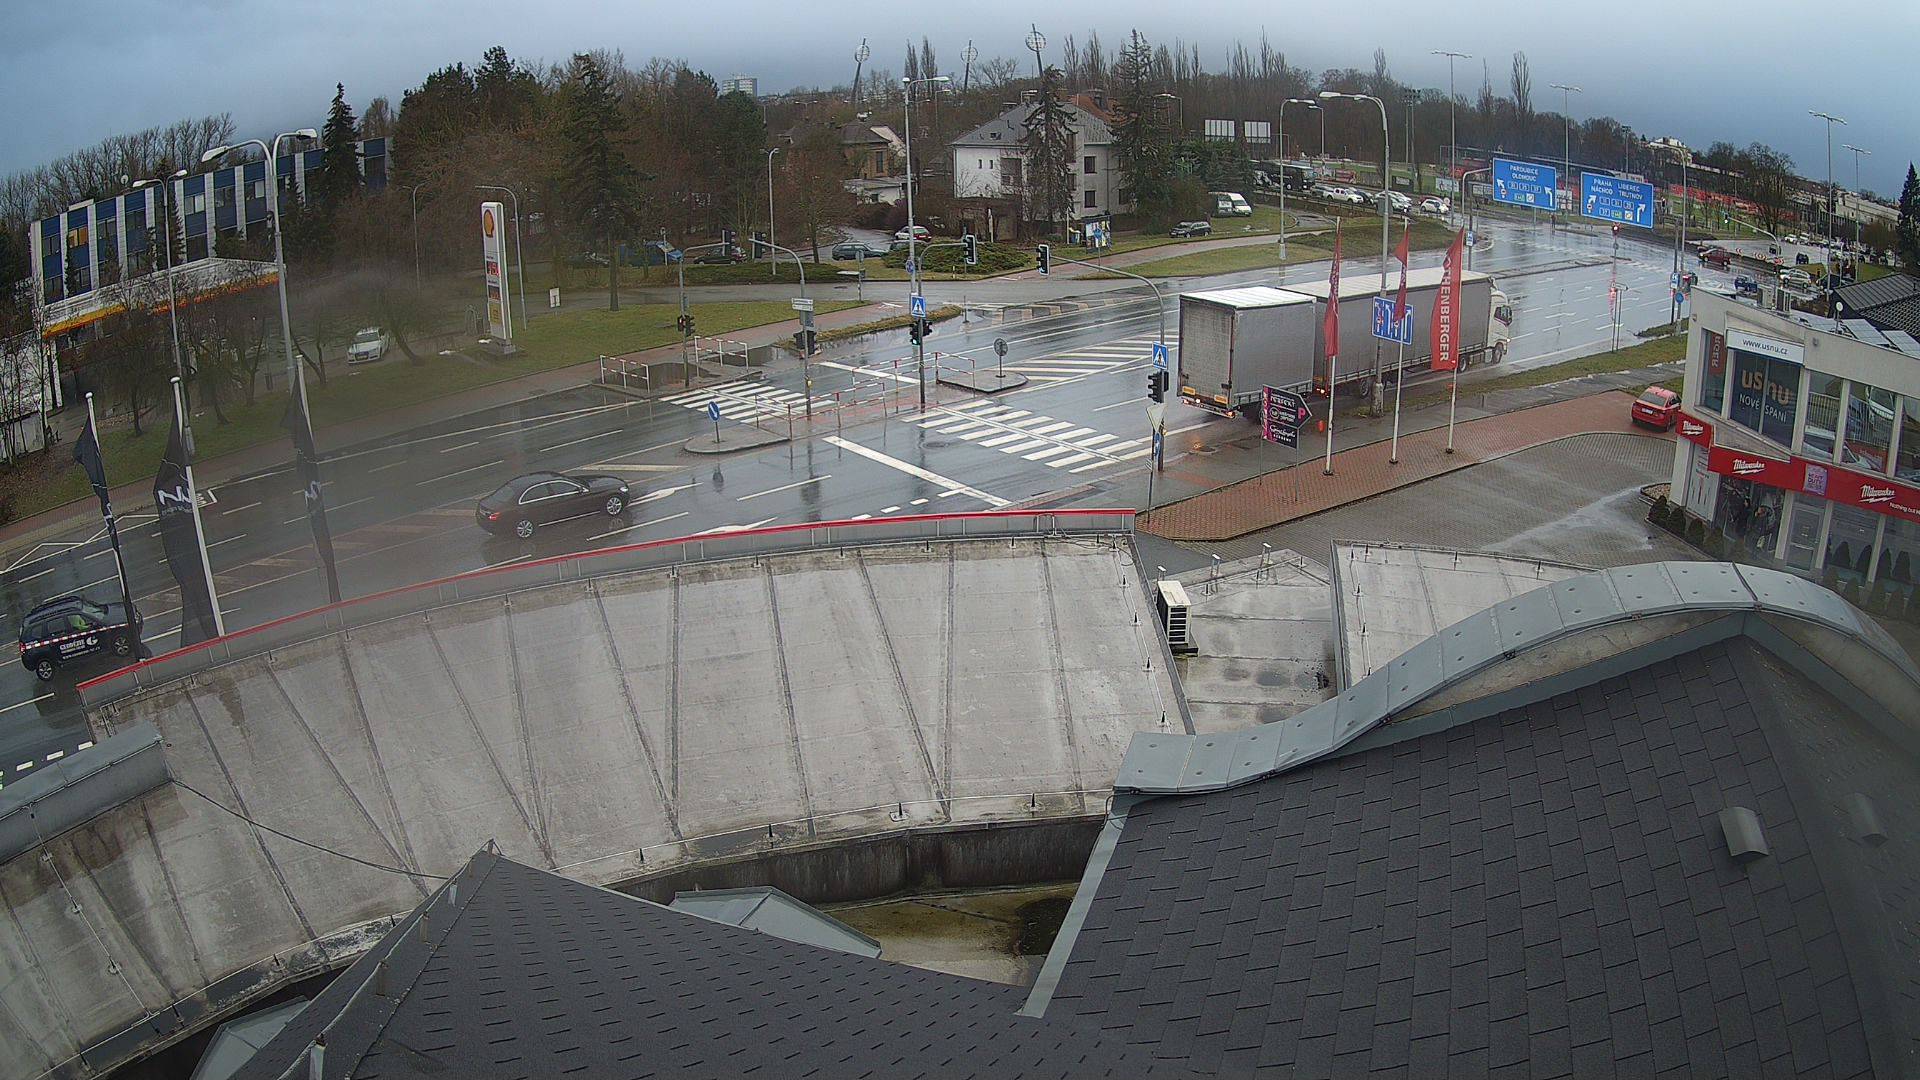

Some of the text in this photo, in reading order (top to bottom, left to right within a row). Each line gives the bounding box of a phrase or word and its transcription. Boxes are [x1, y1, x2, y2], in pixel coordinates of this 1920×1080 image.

[1511, 173, 1537, 182] OLOMOUC
[1593, 178, 1613, 188] PRAHA
[1617, 183, 1641, 193] LIBEREC
[1590, 185, 1614, 195] NÁCHOD
[1619, 190, 1643, 200] TRUTNOV
[1439, 255, 1452, 362] OTHENBERGER
[1742, 338, 1788, 355] www.usnu.cz
[1739, 393, 1787, 423] NOVÉ SPANÍ
[1732, 459, 1765, 471] Milwaukee
[1860, 484, 1895, 498] Milwaukee
[1889, 502, 1908, 512] Nothing
